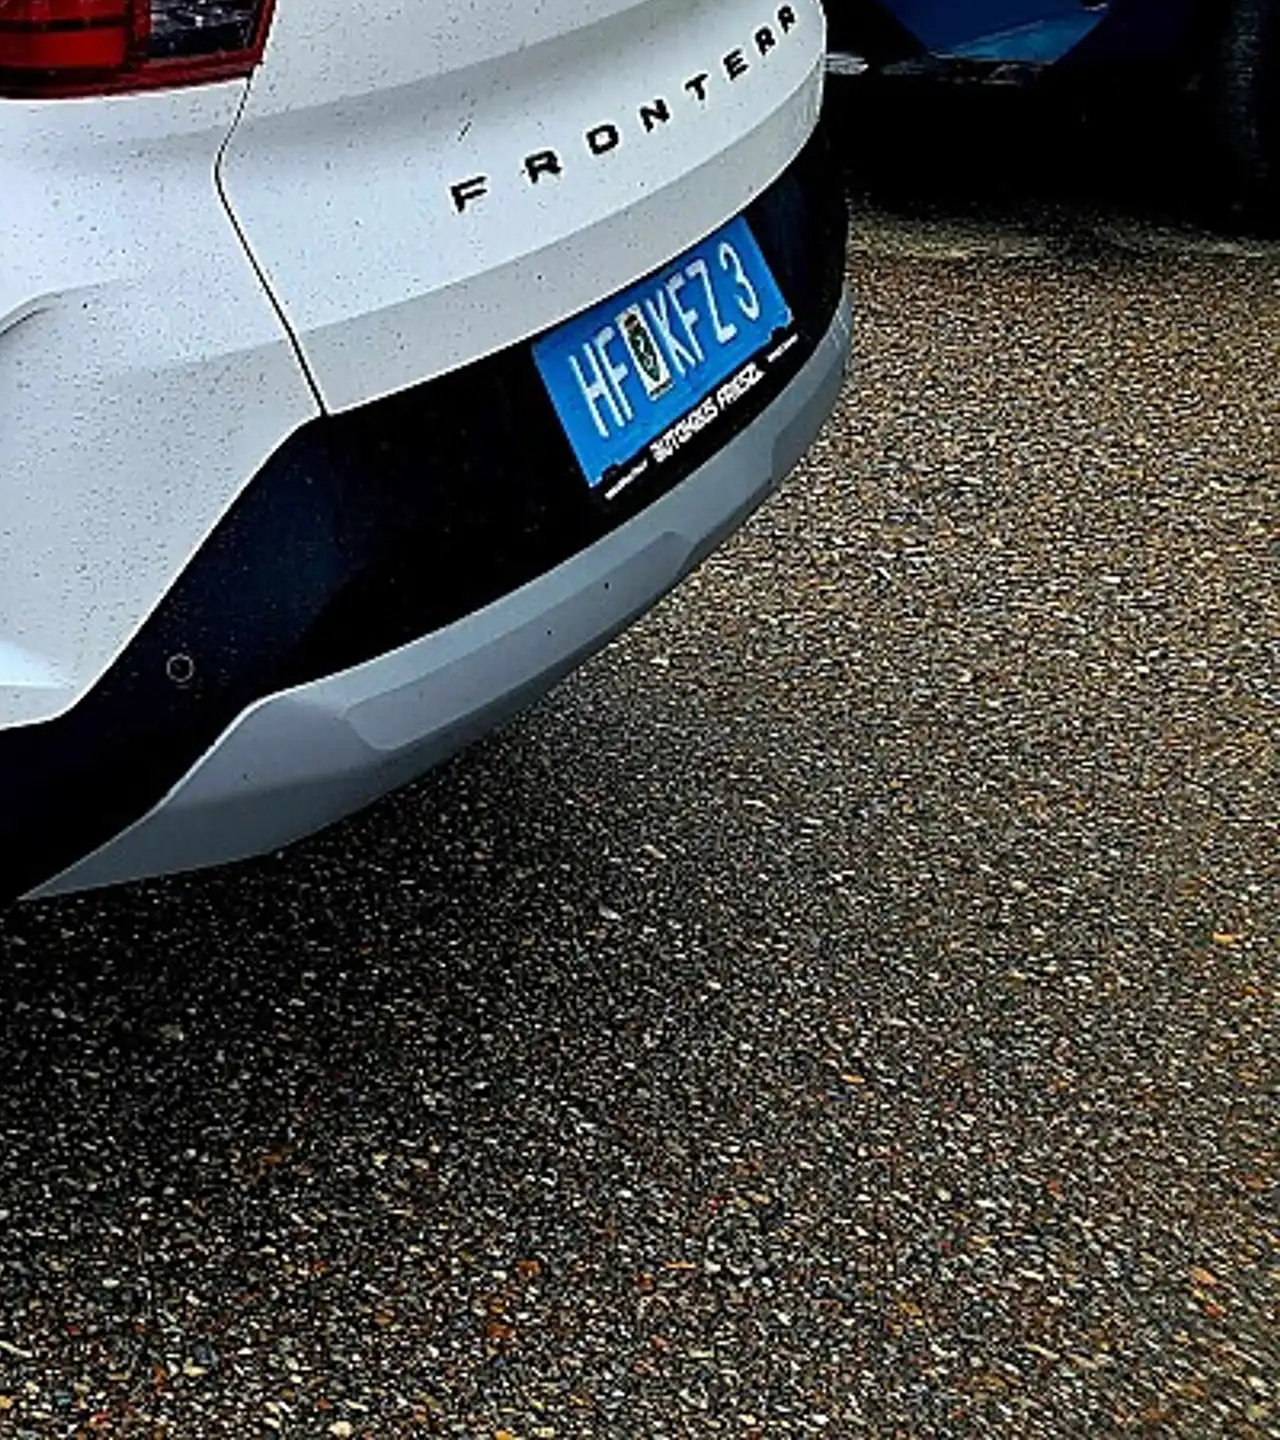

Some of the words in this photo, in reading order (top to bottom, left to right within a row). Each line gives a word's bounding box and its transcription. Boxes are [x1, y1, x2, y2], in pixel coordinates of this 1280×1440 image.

[449, 5, 796, 213] FRONTERA
[568, 326, 630, 438] HF
[644, 259, 738, 377] KFZ
[718, 241, 760, 321] 3
